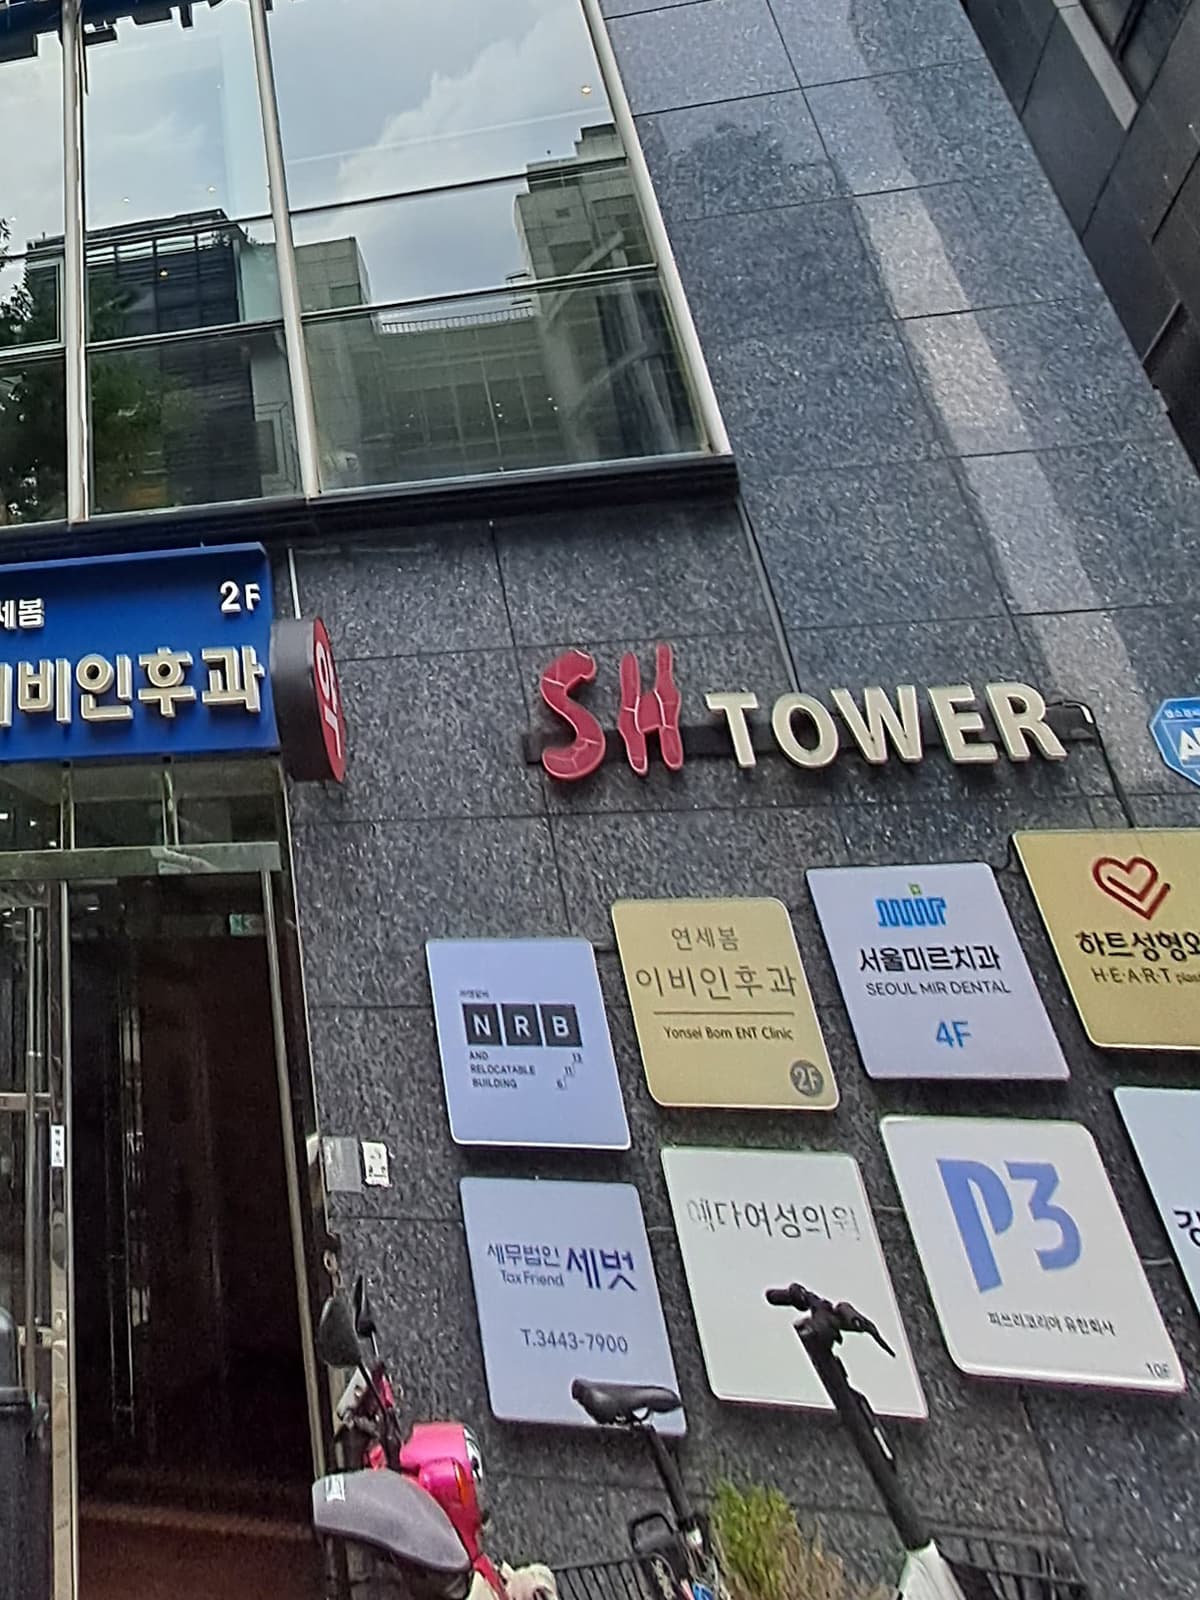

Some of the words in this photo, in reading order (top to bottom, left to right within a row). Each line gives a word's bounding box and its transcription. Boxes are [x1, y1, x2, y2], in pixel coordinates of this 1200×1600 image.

[219, 580, 261, 614] 2F
[540, 642, 686, 782] SH
[705, 681, 1069, 770] TOWER
[671, 926, 740, 952] 연세봄
[859, 944, 1002, 973] 서울미르치과
[635, 964, 798, 1001] 이비인후과
[865, 981, 918, 997] SEOUL
[920, 982, 949, 996] MIR
[951, 979, 1012, 996] DENTAL
[663, 1024, 703, 1040] Yonsei
[705, 1026, 734, 1040] Bom
[736, 1026, 759, 1040] ENT
[761, 1026, 794, 1041] Clinic
[936, 1019, 972, 1049] 4F
[470, 1064, 537, 1076] RELOCATABLE
[472, 1078, 519, 1090] BUILDING
[791, 1064, 820, 1092] 2F
[935, 1157, 1083, 1294] P3
[487, 1242, 561, 1268] 세무법인
[566, 1246, 638, 1292] 세벗
[500, 1269, 523, 1285] Tax
[523, 1271, 565, 1288] Friend
[519, 1327, 629, 1354] T.3443-7900
